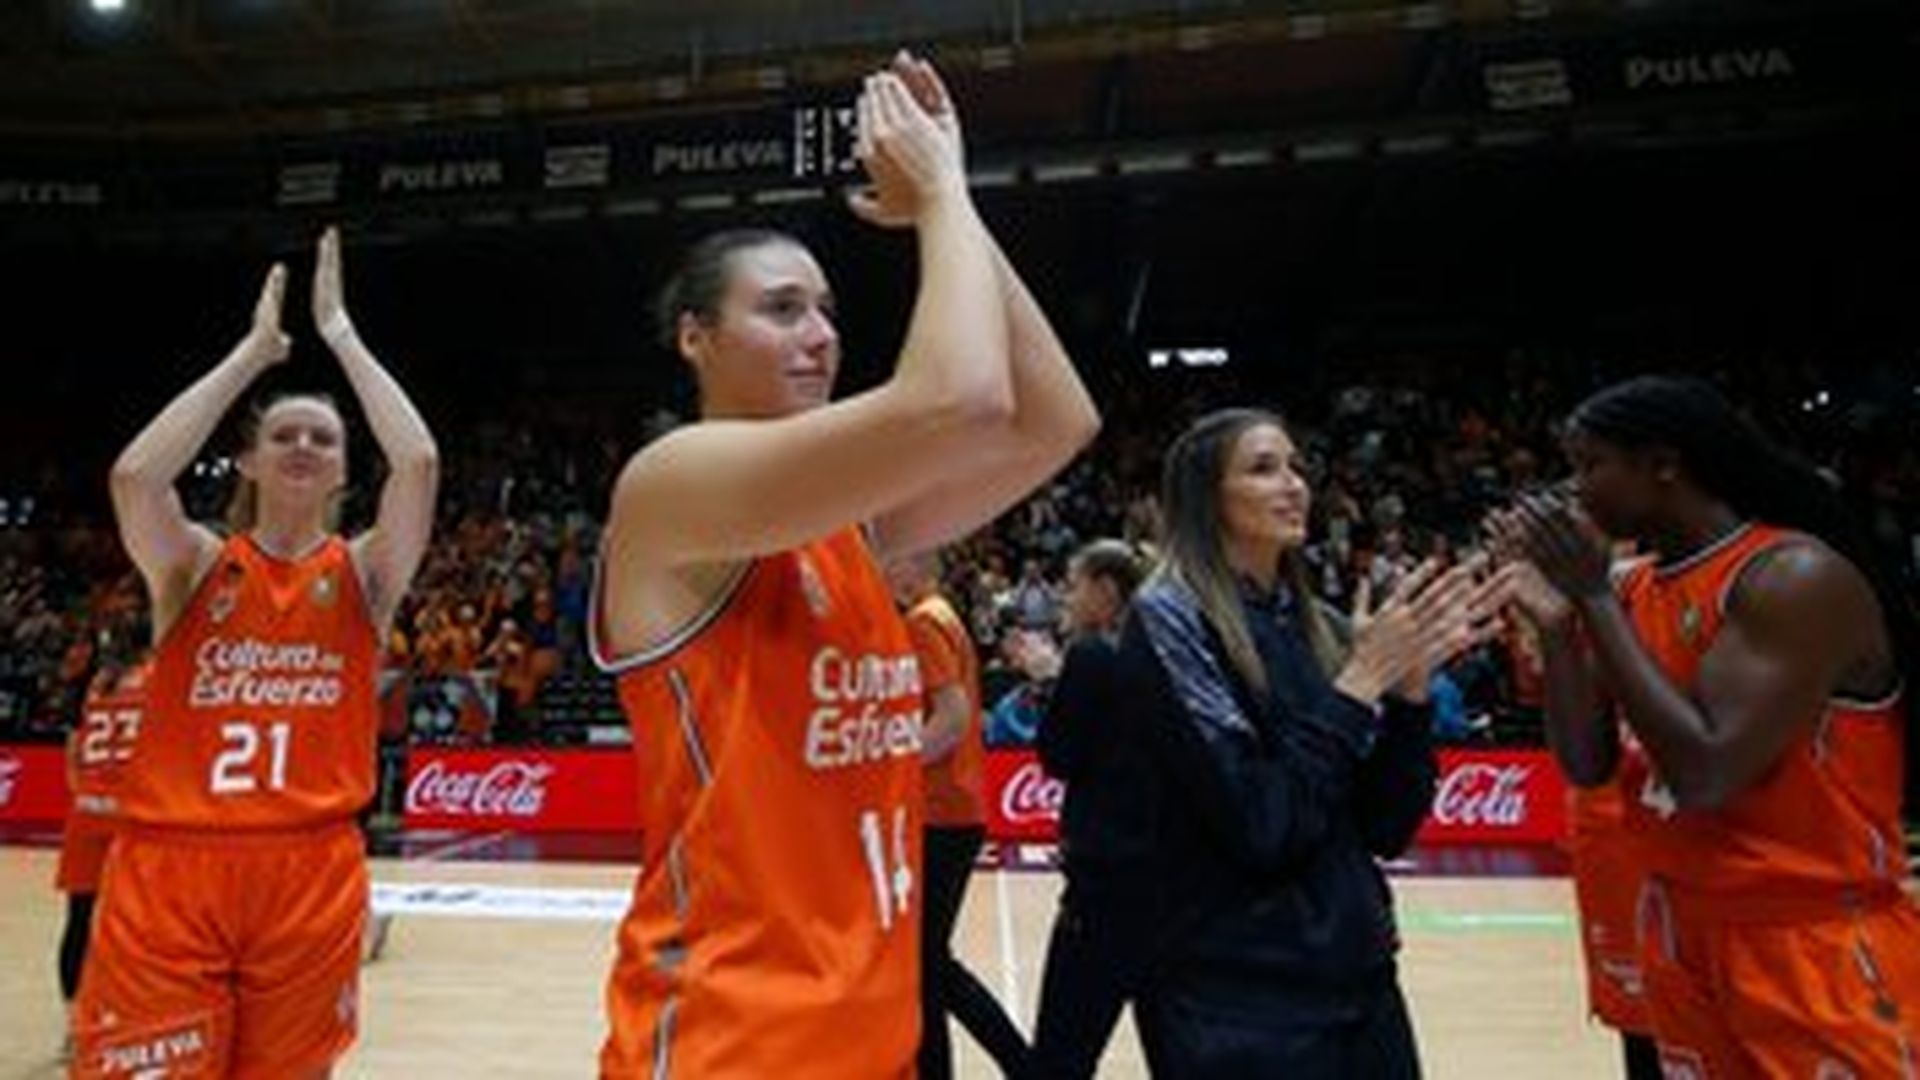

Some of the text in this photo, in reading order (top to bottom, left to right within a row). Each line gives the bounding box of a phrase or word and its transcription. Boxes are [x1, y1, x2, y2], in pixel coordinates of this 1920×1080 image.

[1627, 48, 1793, 88] PULEVA
[653, 138, 784, 173] PULEVA
[380, 160, 501, 191] PULEVA
[210, 722, 291, 794] 21
